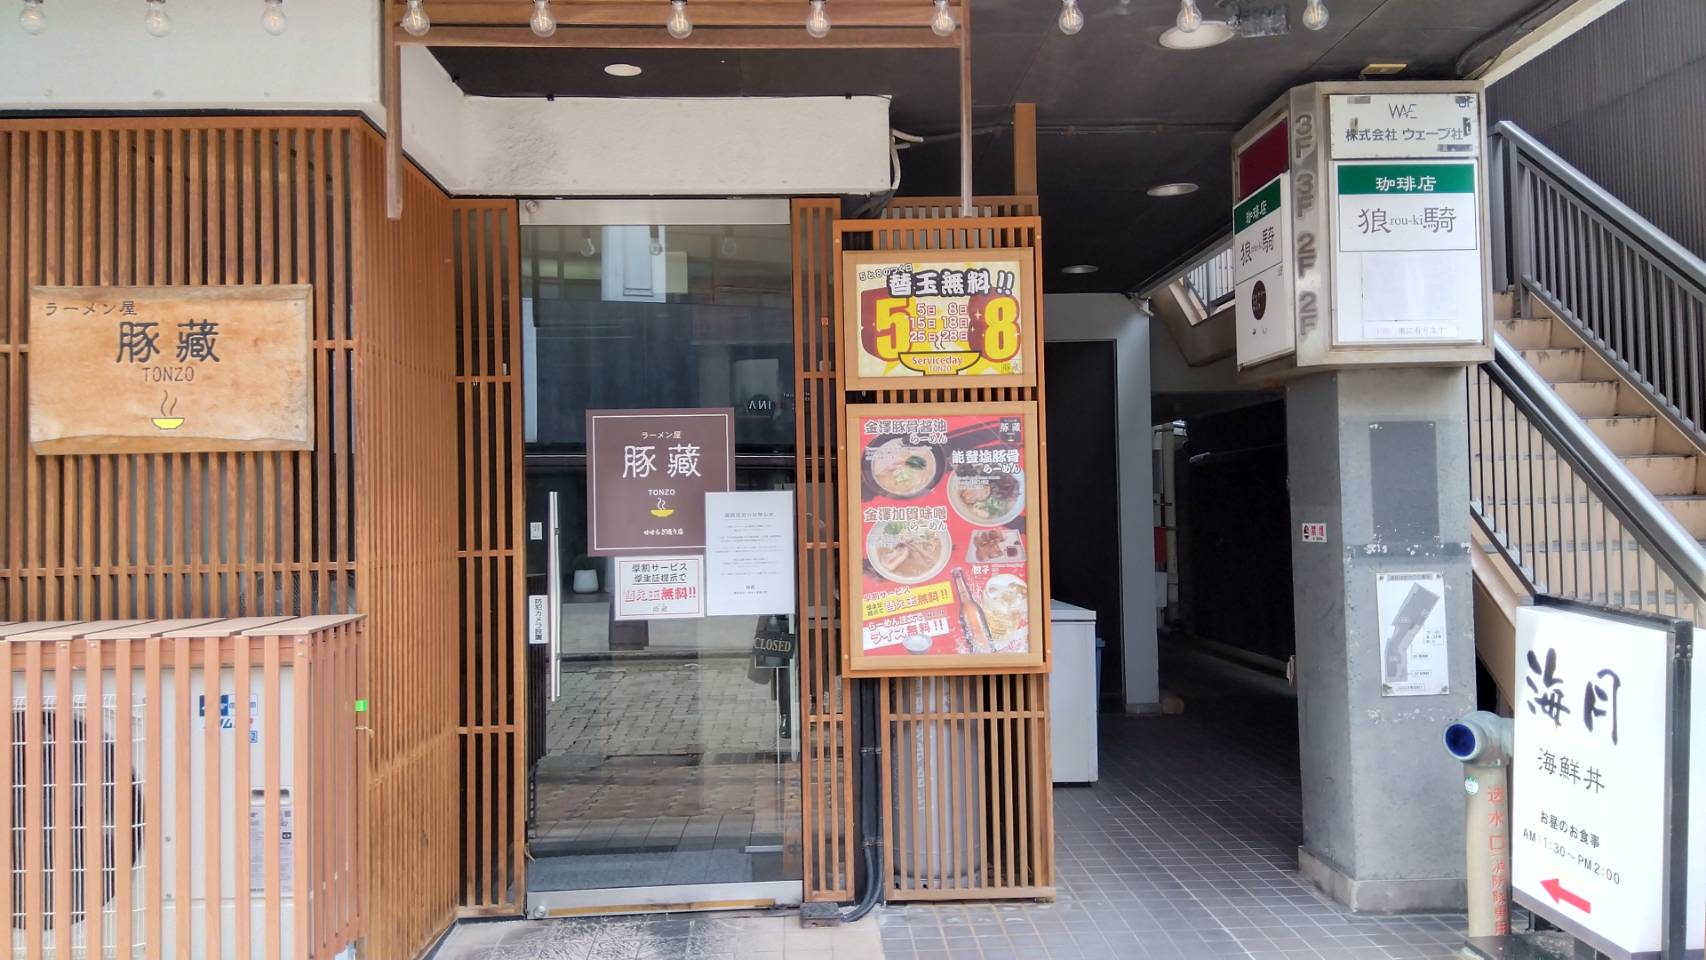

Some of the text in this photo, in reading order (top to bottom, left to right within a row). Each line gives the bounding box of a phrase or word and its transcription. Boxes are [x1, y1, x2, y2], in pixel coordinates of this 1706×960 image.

[1295, 114, 1312, 158] 3F
[1345, 128, 1398, 141] 株式会社
[1375, 175, 1437, 191] 珈琲店
[1296, 173, 1314, 217] 3F
[1244, 200, 1268, 224] 珈琲店
[1297, 233, 1317, 278] 2F
[858, 263, 914, 281] 5と8のつく日
[45, 301, 137, 316] ラーメン屋
[916, 303, 969, 315] 5日 8日
[1299, 291, 1317, 336] 2F
[875, 297, 912, 360] 5
[910, 317, 969, 329] 15日 18日
[983, 296, 1021, 361] 8
[910, 331, 968, 342] 25日 28日
[912, 355, 963, 366] Serviceday
[142, 367, 195, 382] TONZO
[641, 431, 682, 440] ラーメン屋
[909, 433, 948, 444] らーめん
[952, 450, 1020, 464] 能登塩豚骨
[983, 463, 1021, 474] らーめん
[909, 521, 947, 531] らーめん
[754, 638, 792, 653] CLOSED
[1537, 747, 1605, 794] 海鮮丼
[1540, 811, 1600, 848] お昼のお食事
